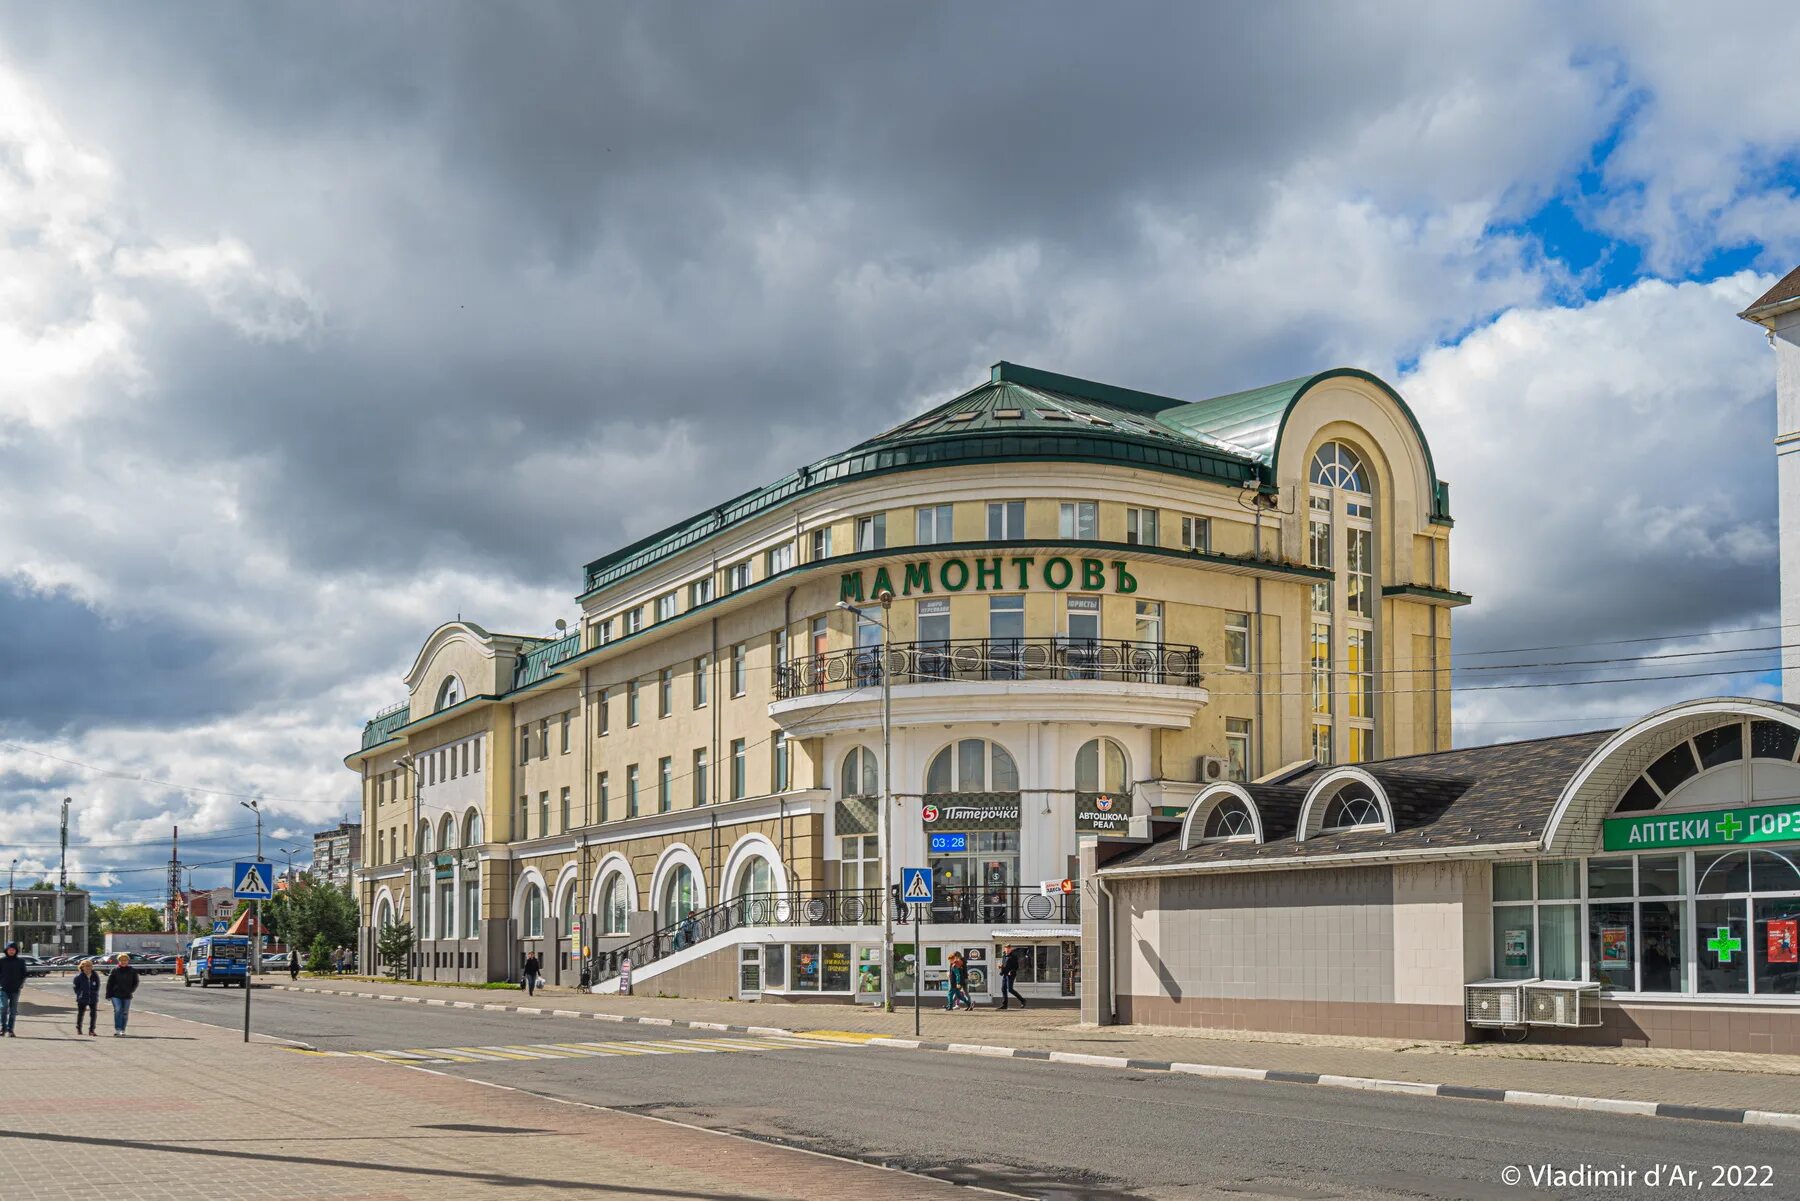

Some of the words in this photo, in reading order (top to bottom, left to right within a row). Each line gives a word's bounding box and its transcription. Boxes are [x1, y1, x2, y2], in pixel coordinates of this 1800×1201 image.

[840, 557, 1138, 602] МАМОНТОВЪ
[1068, 600, 1097, 609] ЮРИСТЫ
[942, 806, 1019, 822] Пятерочка
[1079, 812, 1129, 821] АВТОШКОЛА
[1093, 821, 1115, 829] РЕАЛ
[1628, 818, 1710, 844] АПТЕКИ
